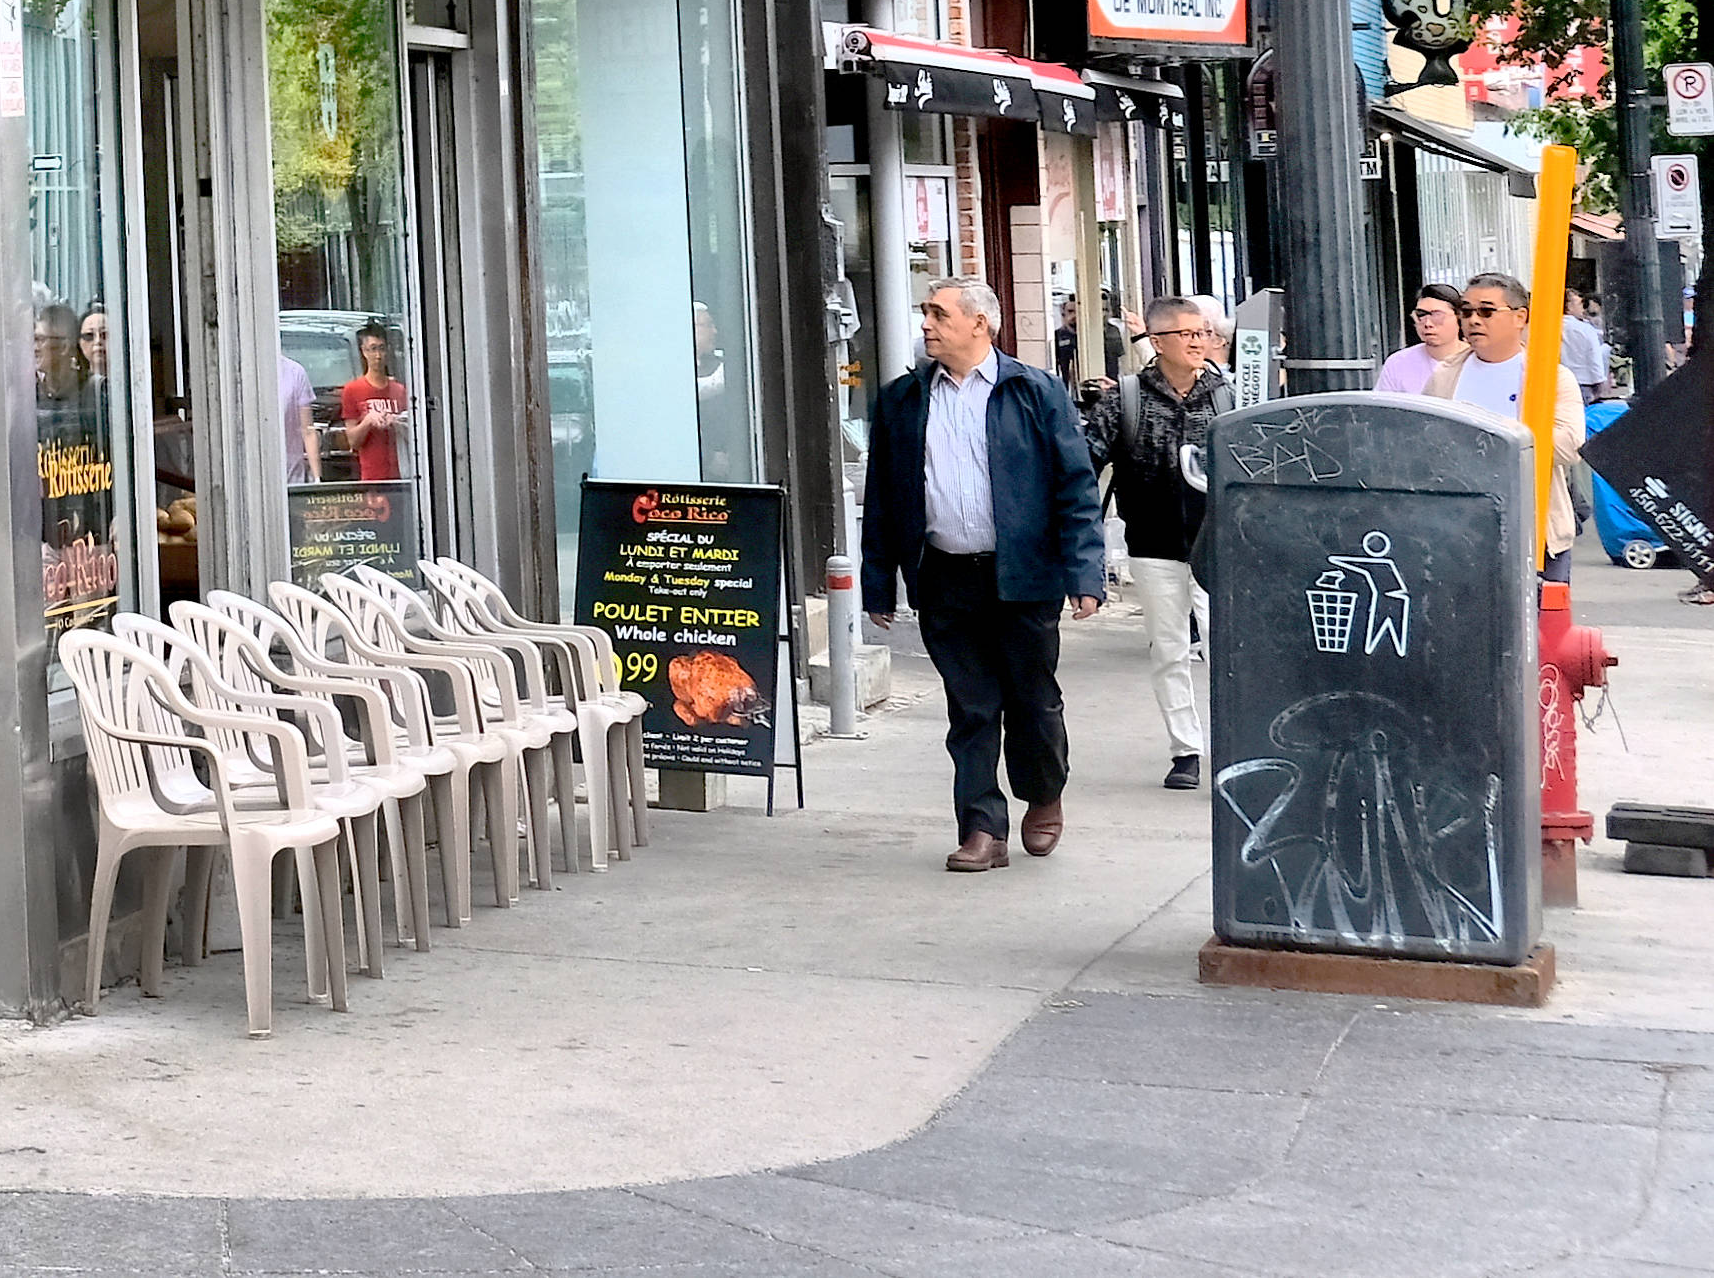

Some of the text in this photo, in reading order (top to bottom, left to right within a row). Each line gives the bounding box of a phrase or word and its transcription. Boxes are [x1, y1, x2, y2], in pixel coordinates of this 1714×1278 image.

[686, 506, 729, 521] Rico
[646, 529, 714, 544] SPÉCIAL DU
[619, 544, 740, 561] LUNDI ET MARDI
[604, 571, 647, 585] Monday
[663, 574, 710, 588] Tuesday
[714, 578, 753, 591] special
[593, 601, 760, 627] POULET ENTIER
[614, 625, 737, 646] Whole chicken
